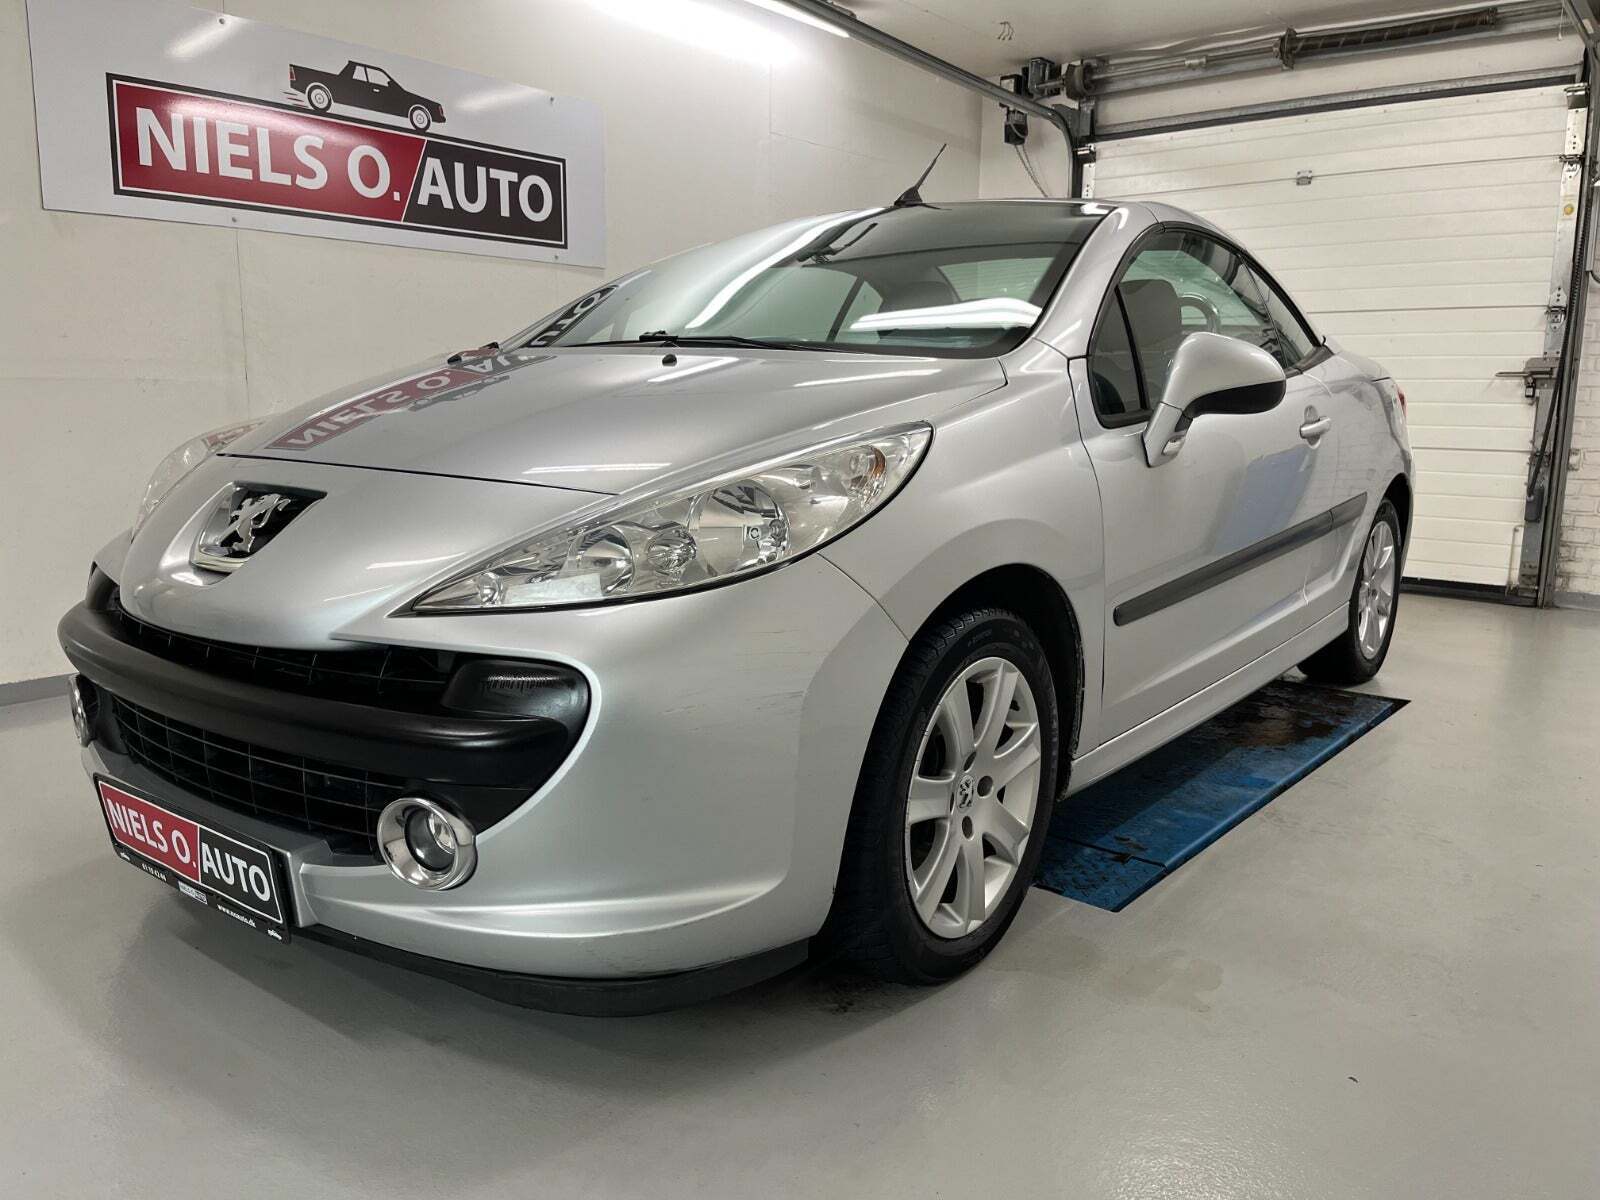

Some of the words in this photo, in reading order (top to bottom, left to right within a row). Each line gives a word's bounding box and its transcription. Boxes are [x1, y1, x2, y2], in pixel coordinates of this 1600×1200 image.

[135, 106, 329, 191] NIELS
[346, 144, 402, 202] O.
[417, 157, 554, 223] AUTO
[106, 798, 169, 853] NIELS
[171, 829, 197, 868] O.
[201, 841, 271, 902] AUTO
